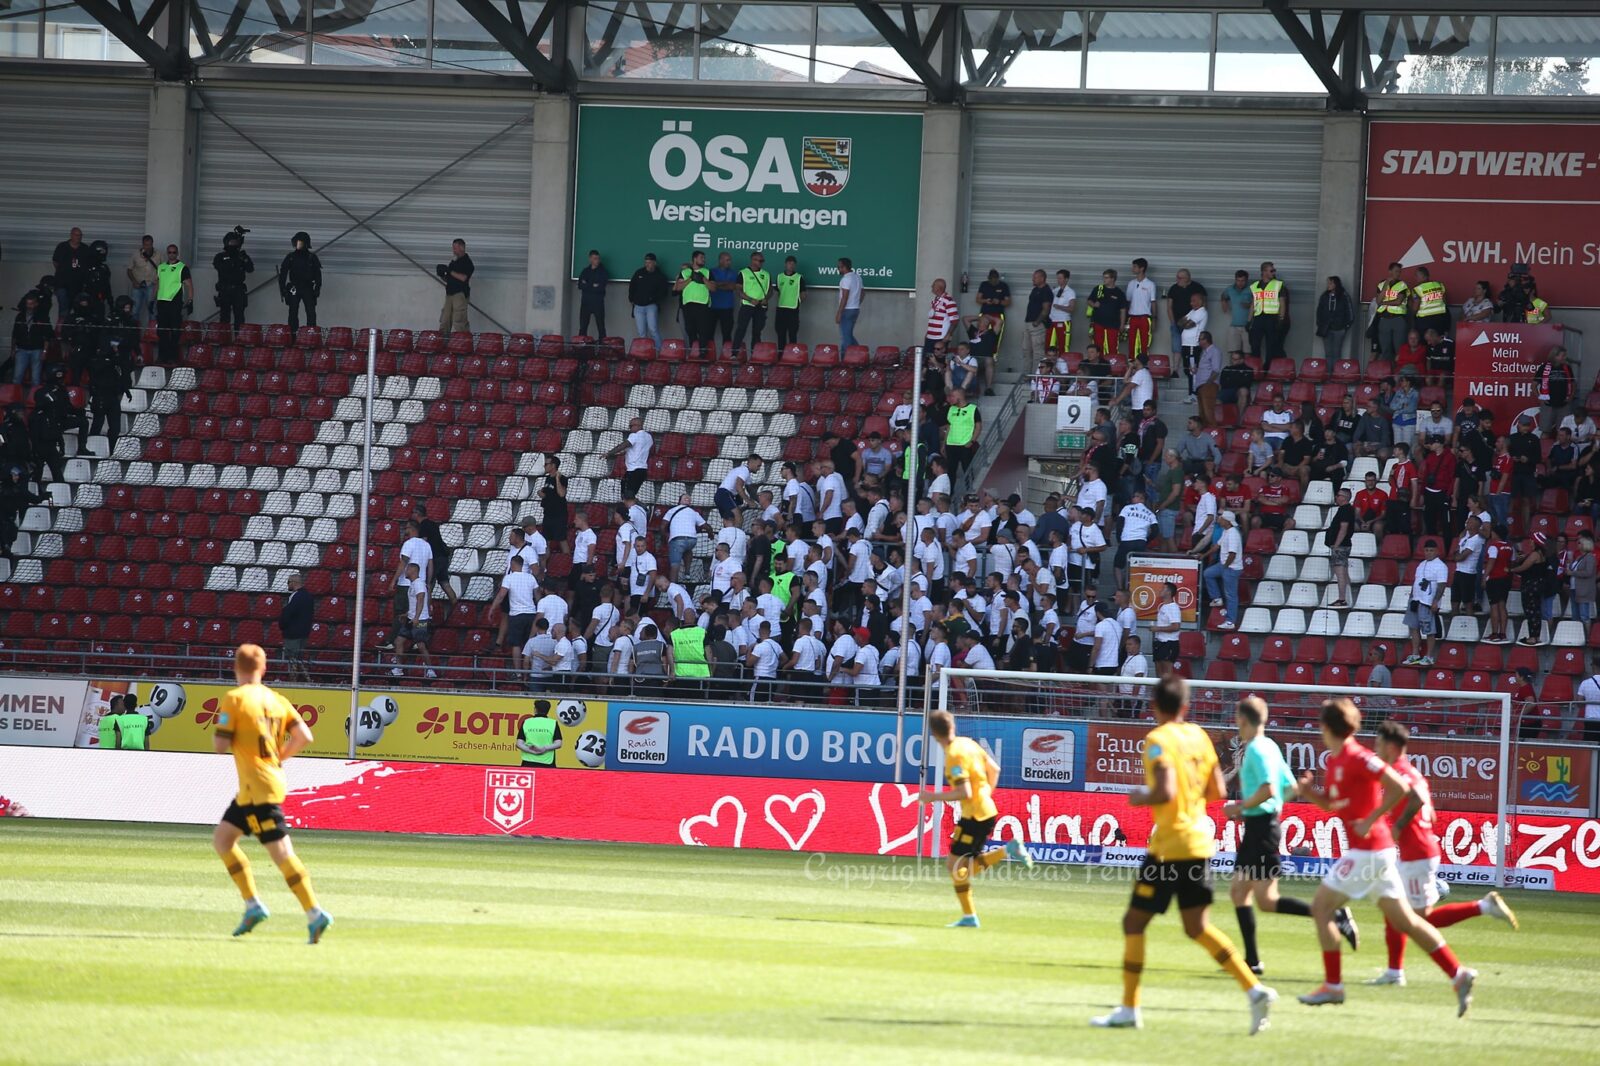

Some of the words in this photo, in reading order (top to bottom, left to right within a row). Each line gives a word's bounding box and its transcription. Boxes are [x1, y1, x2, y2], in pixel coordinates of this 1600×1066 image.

[649, 120, 800, 192] ÖSA
[1381, 149, 1600, 177] STADTWERKE-
[648, 199, 847, 230] Versicherungen
[717, 237, 799, 252] Finanzgruppe
[1442, 240, 1507, 264] SWH.
[1514, 242, 1573, 265] Mein
[1493, 332, 1522, 344] SWH.
[1492, 347, 1519, 359] Mein
[1491, 361, 1543, 374] Stadtwer
[1469, 381, 1509, 397] Mein
[1514, 382, 1532, 397] HF
[1067, 404, 1081, 424] 9
[359, 710, 382, 730] 49
[559, 705, 581, 726] 38
[13, 718, 57, 732] EDEL.
[452, 741, 518, 752] Sachsen-Anhalt
[582, 734, 607, 758] 23
[627, 738, 657, 749] Radio
[687, 724, 810, 761] RADIO
[821, 731, 1002, 770] BROCN
[620, 748, 665, 761] Brocken
[1096, 753, 1132, 773] ein
[491, 774, 529, 787] HFC
[1024, 767, 1070, 780] Brocken
[1448, 791, 1467, 799] Halle
[1468, 791, 1493, 801] (Saale)
[1466, 871, 1490, 881] die
